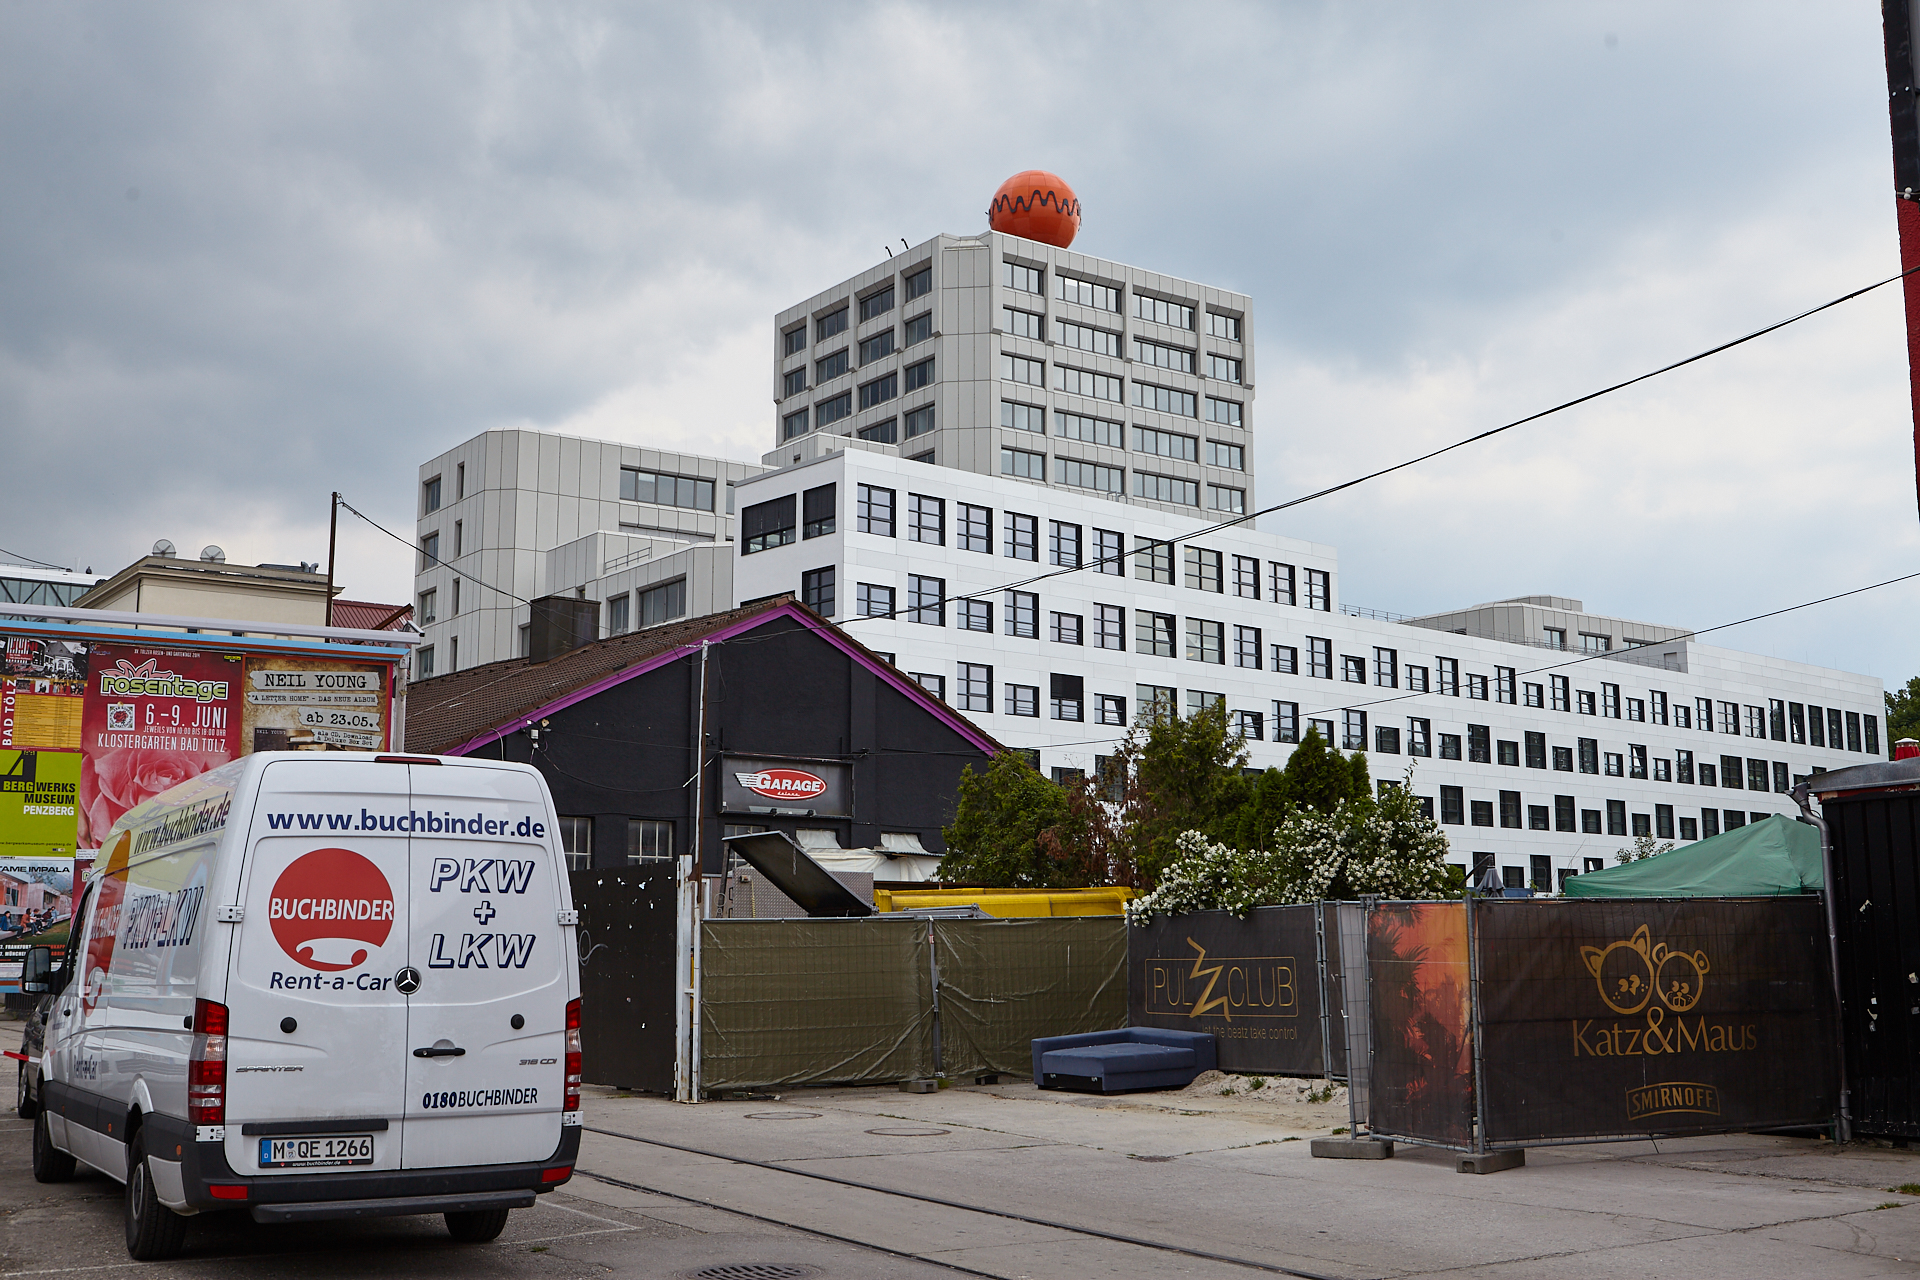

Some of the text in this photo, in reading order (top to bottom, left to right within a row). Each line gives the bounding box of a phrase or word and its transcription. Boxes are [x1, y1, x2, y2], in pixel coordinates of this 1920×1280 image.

[101, 675, 228, 703] rosentage
[265, 673, 367, 688] NEIL YOUNG
[2, 680, 16, 746] BAD TÖLZ
[191, 706, 228, 729] JUNI
[306, 711, 374, 727] ab 23.05.
[166, 726, 176, 734] VON
[98, 733, 177, 750] KLOSTERGÄRTEN
[180, 737, 198, 751] BAD
[757, 773, 821, 792] GARAGE
[24, 793, 75, 805] MUSEUM
[23, 805, 75, 816] PENZBERG
[134, 791, 231, 855] www.buchbinder.de
[268, 809, 545, 839] www.buchbinder.de
[430, 857, 535, 894] PKW
[269, 898, 394, 921] BUCHBINDER
[428, 933, 536, 969] LKW
[270, 971, 393, 991] Rent-a-Car
[1250, 1025, 1266, 1039] take
[1268, 1026, 1298, 1040] control
[1572, 1006, 1757, 1057] Katz&Maus
[235, 1064, 304, 1073] SPRINTER
[540, 1057, 557, 1065] CDI
[1632, 1086, 1714, 1115] SMIRNOFF
[273, 1139, 370, 1159] M QE 1266
